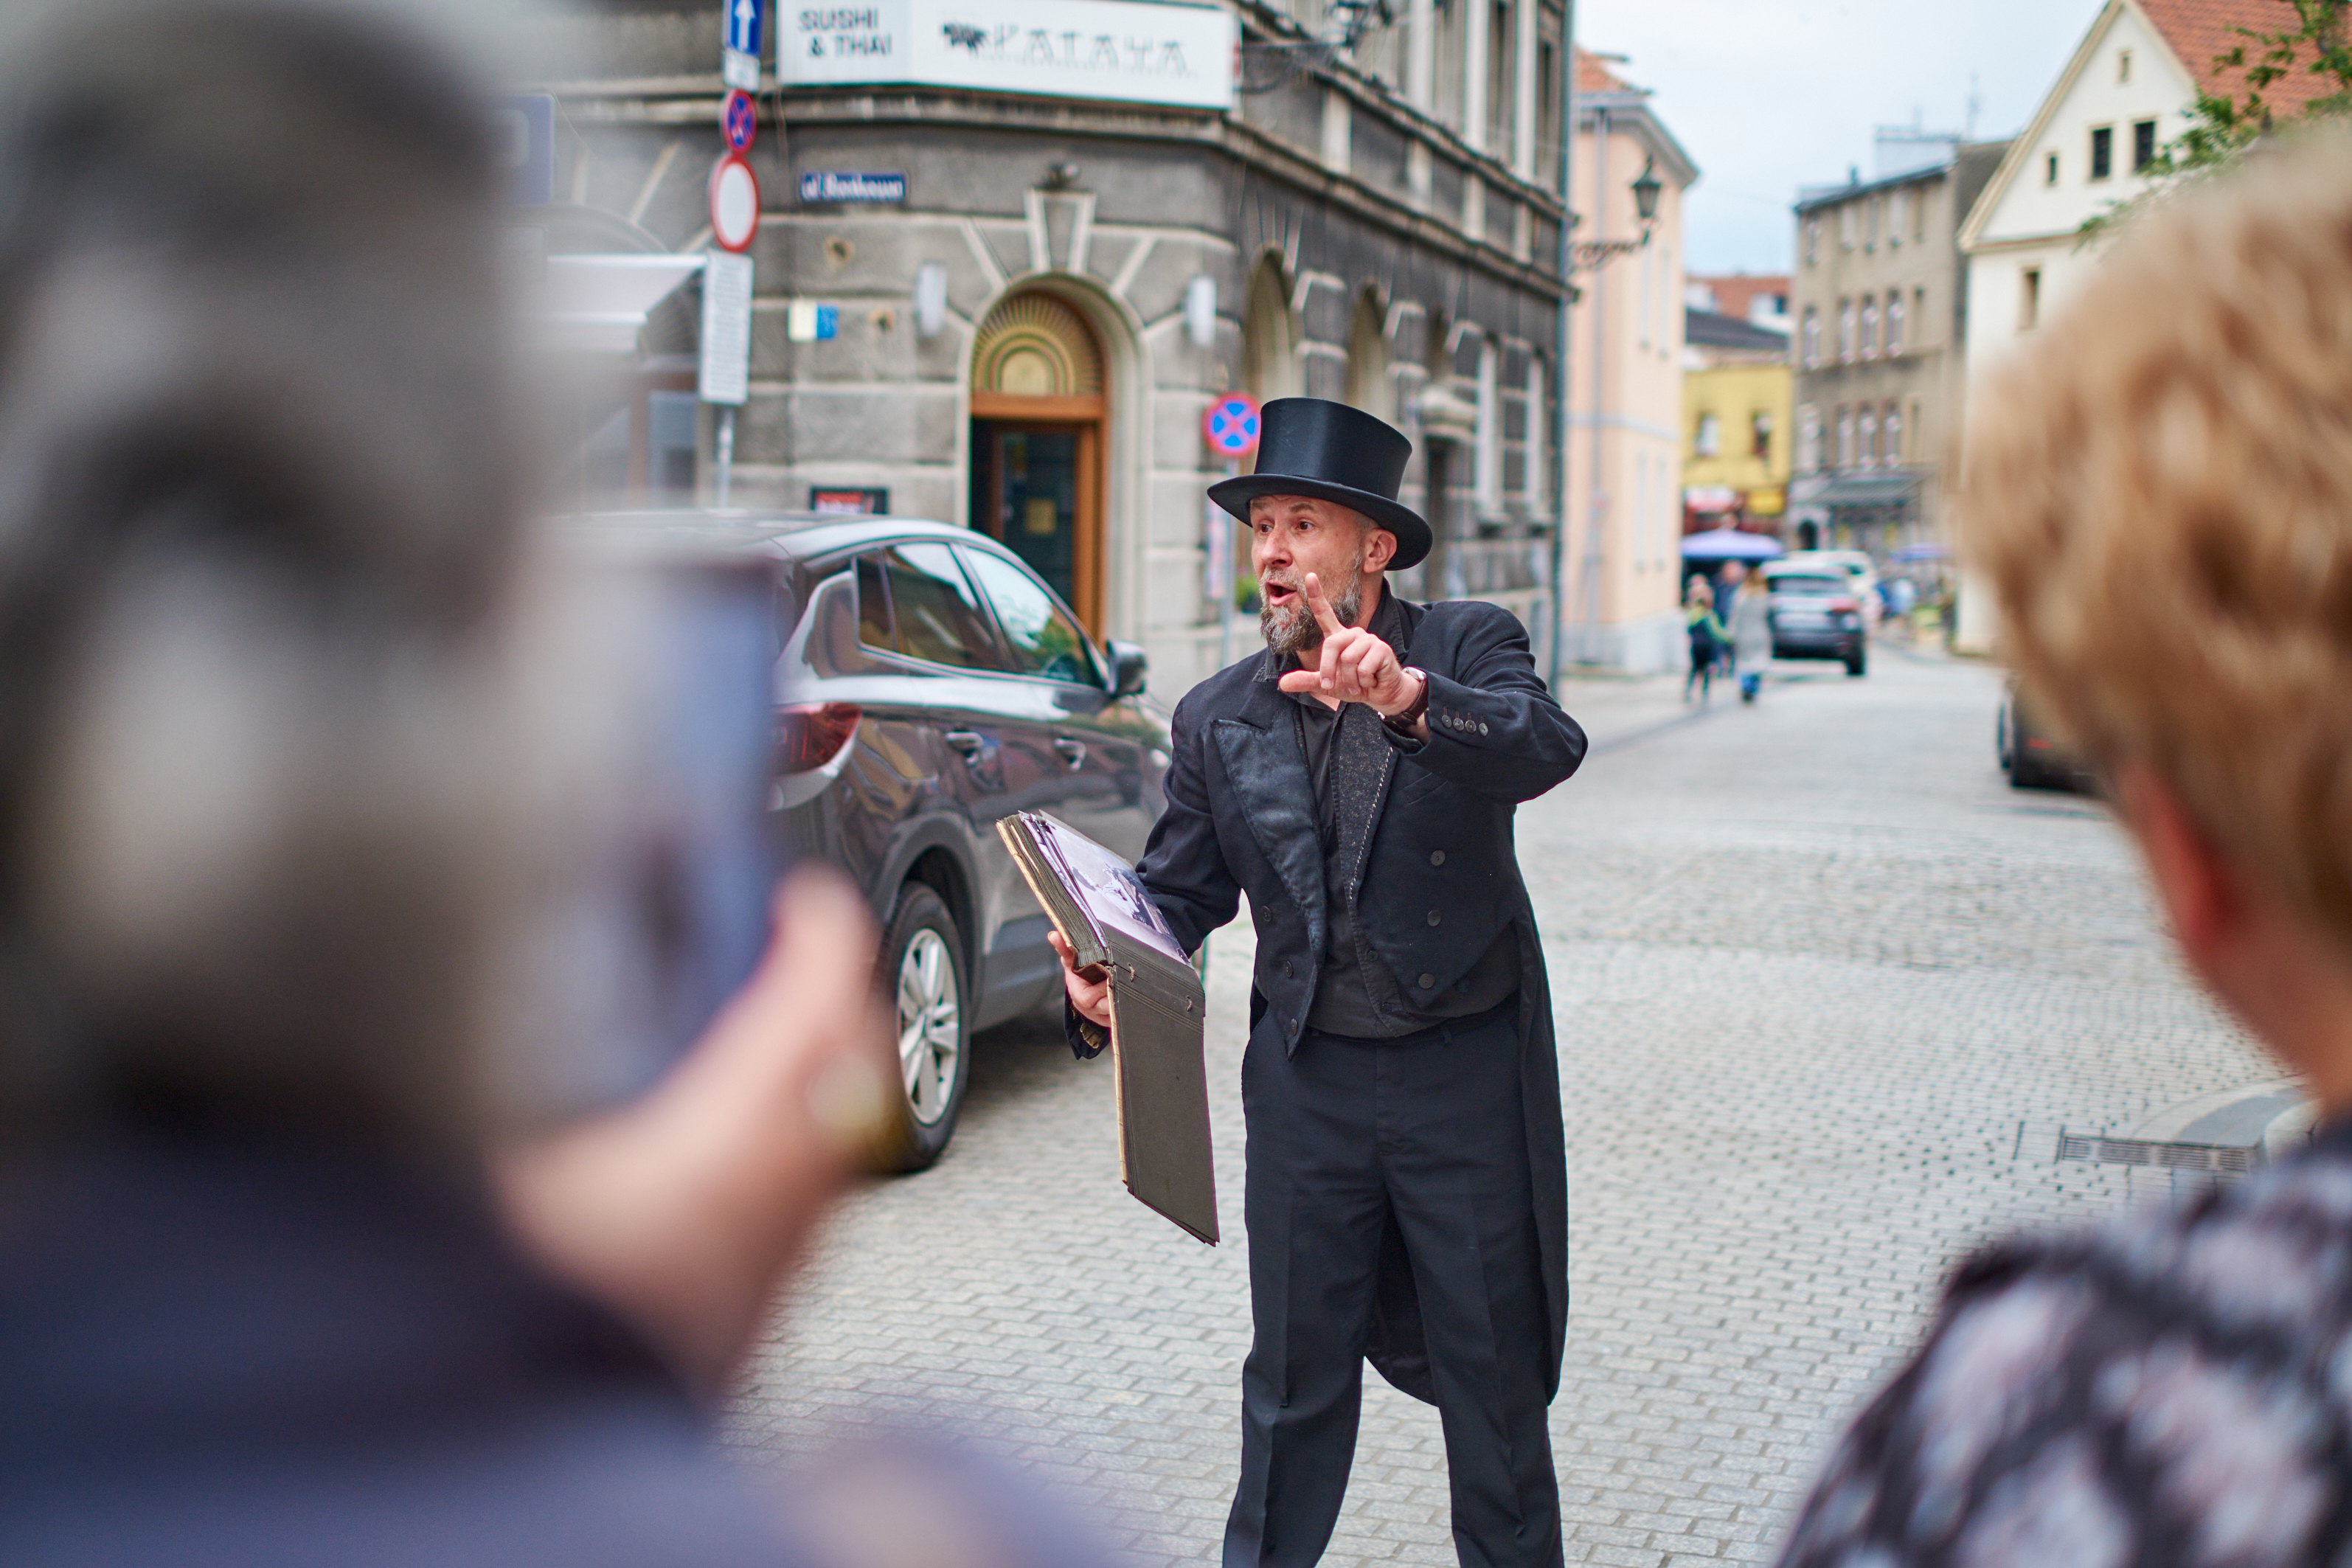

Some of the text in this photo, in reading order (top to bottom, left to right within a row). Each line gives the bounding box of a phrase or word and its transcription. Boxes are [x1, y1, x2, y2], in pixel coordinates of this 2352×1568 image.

[799, 9, 878, 31] SUSHI
[809, 34, 892, 57] & THAI
